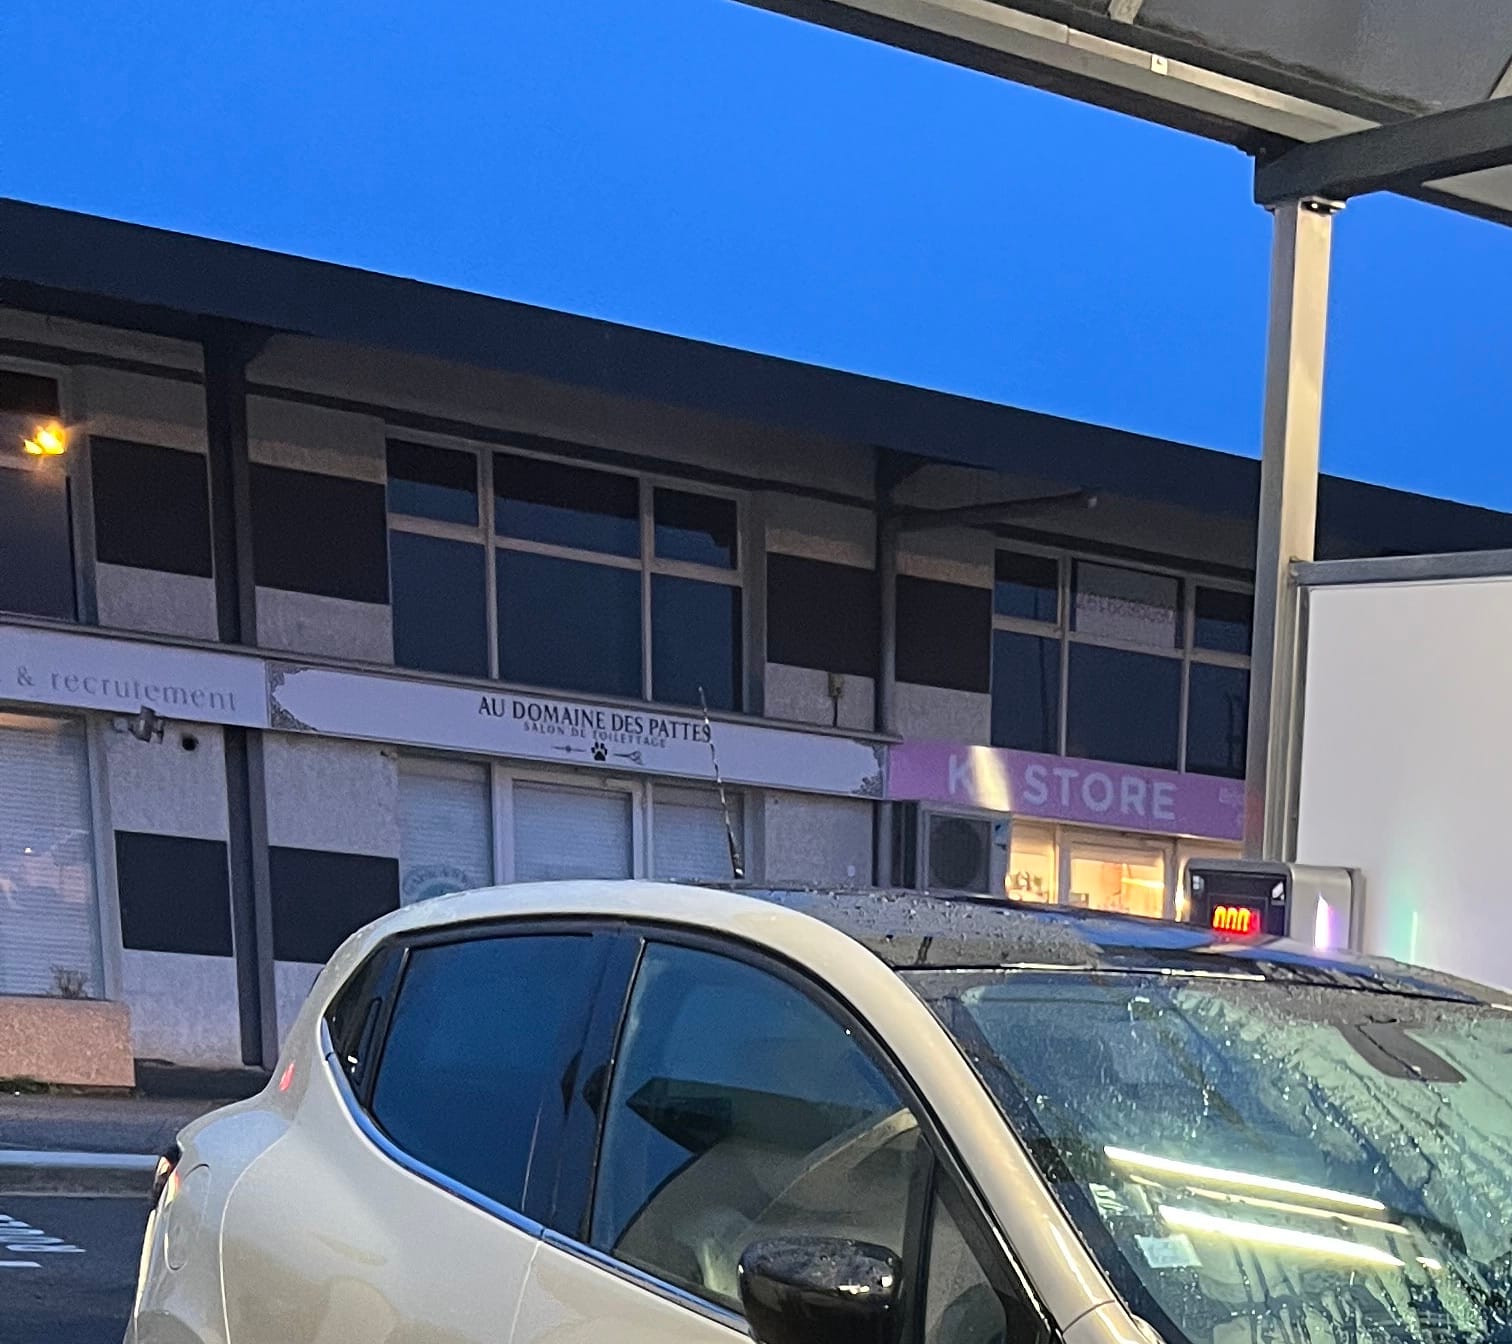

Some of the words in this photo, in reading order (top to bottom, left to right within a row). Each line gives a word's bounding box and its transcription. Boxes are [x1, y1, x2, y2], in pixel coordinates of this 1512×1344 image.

[17, 666, 34, 687] &
[51, 671, 237, 712] recrutement
[478, 696, 505, 718] AU
[512, 700, 606, 730] DOMAINE
[611, 713, 643, 736] DES
[648, 718, 711, 744] PATTES
[523, 720, 565, 736] SALON
[592, 729, 666, 749] TOILETTAGE
[1022, 763, 1178, 822] STORE
